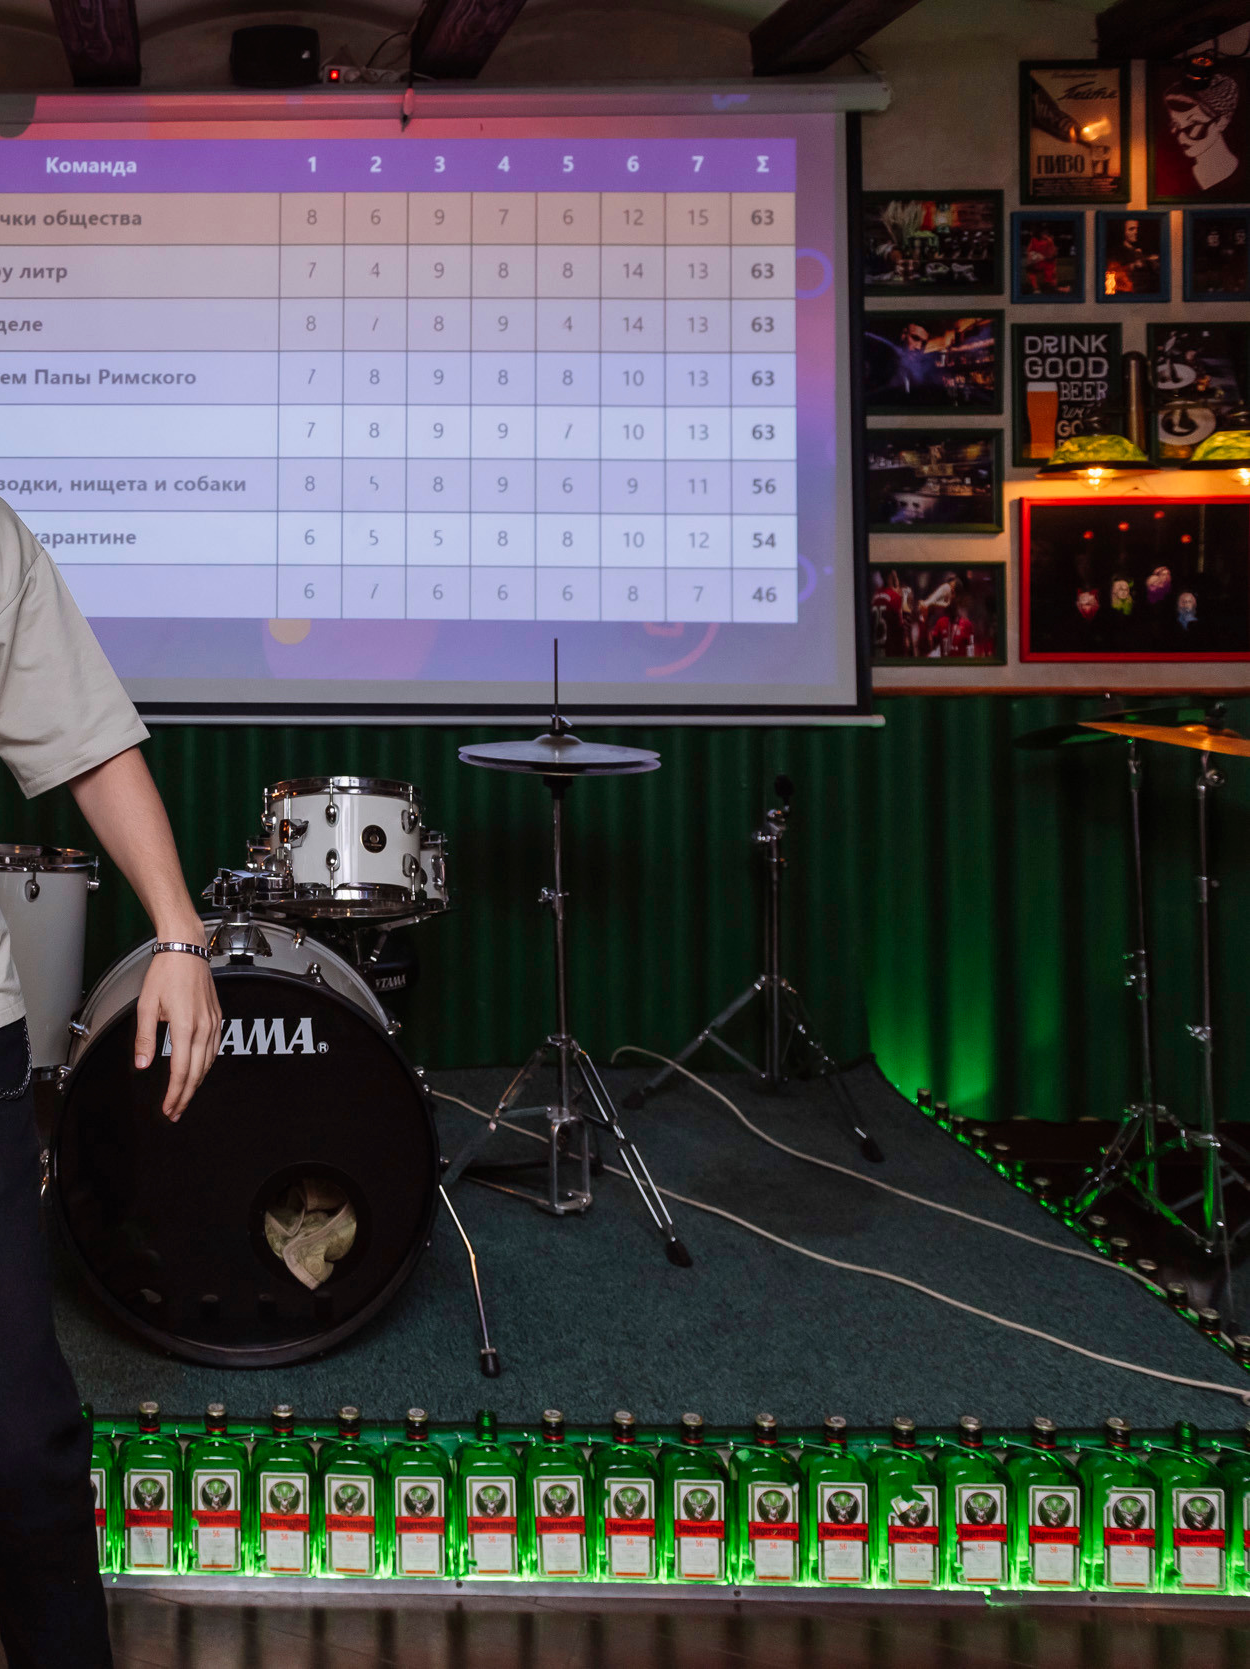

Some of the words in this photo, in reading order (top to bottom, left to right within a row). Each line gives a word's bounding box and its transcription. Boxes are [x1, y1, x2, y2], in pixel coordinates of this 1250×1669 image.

[46, 157, 137, 176] Команда
[308, 156, 316, 172] 1
[370, 156, 381, 173] 2
[435, 156, 445, 172] 3
[498, 156, 510, 172] 4
[563, 156, 574, 172] 5
[627, 156, 639, 172] 6
[692, 156, 704, 172] 7
[1037, 155, 1085, 174] ПИВО
[43, 210, 142, 229] общества
[307, 209, 317, 225] 8
[371, 209, 381, 225] 6
[434, 209, 445, 225] 9
[499, 209, 509, 225] 7
[563, 209, 574, 225] 6
[624, 209, 643, 226] 12
[688, 209, 709, 226] 15
[751, 210, 774, 225] 63
[19, 267, 67, 283] литр
[309, 262, 316, 278] 7
[371, 262, 380, 278] 4
[434, 262, 444, 279] 9
[498, 262, 509, 279] 8
[562, 262, 573, 279] 8
[624, 263, 643, 278] 14
[688, 262, 708, 279] 13
[751, 263, 774, 279] 63
[306, 315, 316, 332] 8
[433, 315, 444, 332] 8
[498, 316, 509, 332] 9
[564, 316, 573, 331] 4
[623, 317, 644, 332] 14
[688, 316, 708, 333] 13
[751, 317, 774, 333] 63
[1024, 335, 1108, 354] DRINK
[1024, 357, 1109, 379] GOOD
[35, 369, 90, 384] Папы
[99, 369, 196, 384] Римского
[369, 369, 380, 385] 8
[433, 369, 444, 385] 9
[498, 369, 509, 385] 8
[562, 369, 573, 386] 8
[623, 370, 644, 386] 10
[688, 370, 709, 387] 13
[752, 371, 774, 386] 63
[1059, 382, 1108, 401] BEER
[307, 422, 316, 438] 7
[369, 422, 380, 438] 8
[433, 423, 444, 439] 9
[498, 423, 508, 439] 9
[623, 424, 644, 440] 10
[689, 424, 709, 441] 13
[752, 424, 775, 440] 63
[71, 480, 147, 494] нищета
[155, 480, 166, 491] и
[174, 476, 246, 491] собаки
[305, 475, 315, 492] 8
[433, 476, 444, 493] 8
[497, 476, 508, 493] 9
[562, 477, 573, 493] 6
[627, 478, 638, 494] 9
[689, 478, 707, 494] 11
[753, 479, 776, 494] 56
[304, 529, 315, 545] 6
[369, 529, 379, 546] 5
[434, 530, 443, 546] 5
[497, 530, 508, 547] 8
[562, 531, 573, 547] 8
[623, 532, 645, 548] 10
[689, 532, 709, 548] 12
[753, 533, 776, 548] 54
[304, 583, 315, 599] 6
[433, 584, 443, 600] 6
[497, 584, 508, 601] 6
[562, 585, 573, 601] 6
[627, 586, 639, 602] 8
[693, 586, 704, 602] 7
[752, 587, 777, 602] 46
[381, 974, 406, 989] TAMA
[218, 1017, 316, 1056] AMA
